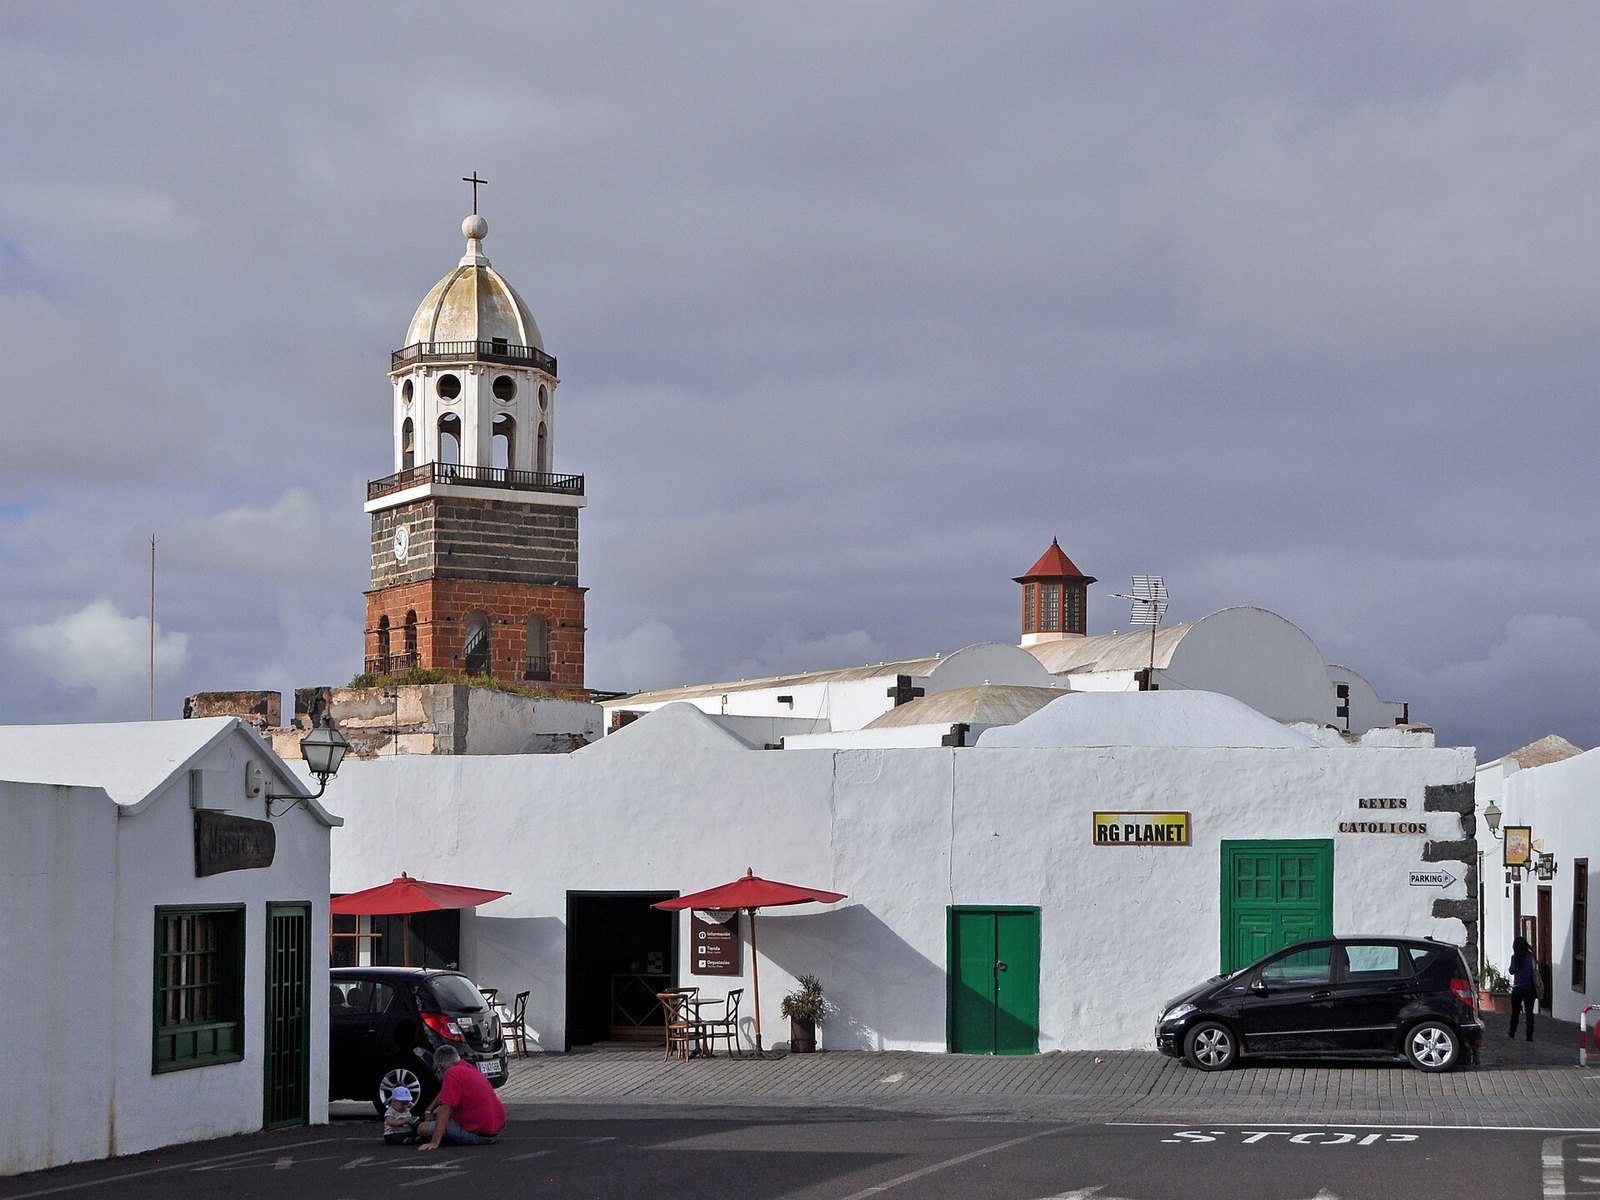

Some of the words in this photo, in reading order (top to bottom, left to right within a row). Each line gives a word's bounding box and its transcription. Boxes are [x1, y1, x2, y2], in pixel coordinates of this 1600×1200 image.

[1358, 798, 1407, 809] REYES
[1097, 823, 1120, 842] RG
[1124, 823, 1184, 842] PLANET
[1338, 822, 1427, 834] CATOLICOS
[1411, 874, 1443, 883] PARKING
[1160, 1130, 1420, 1145] STOP
